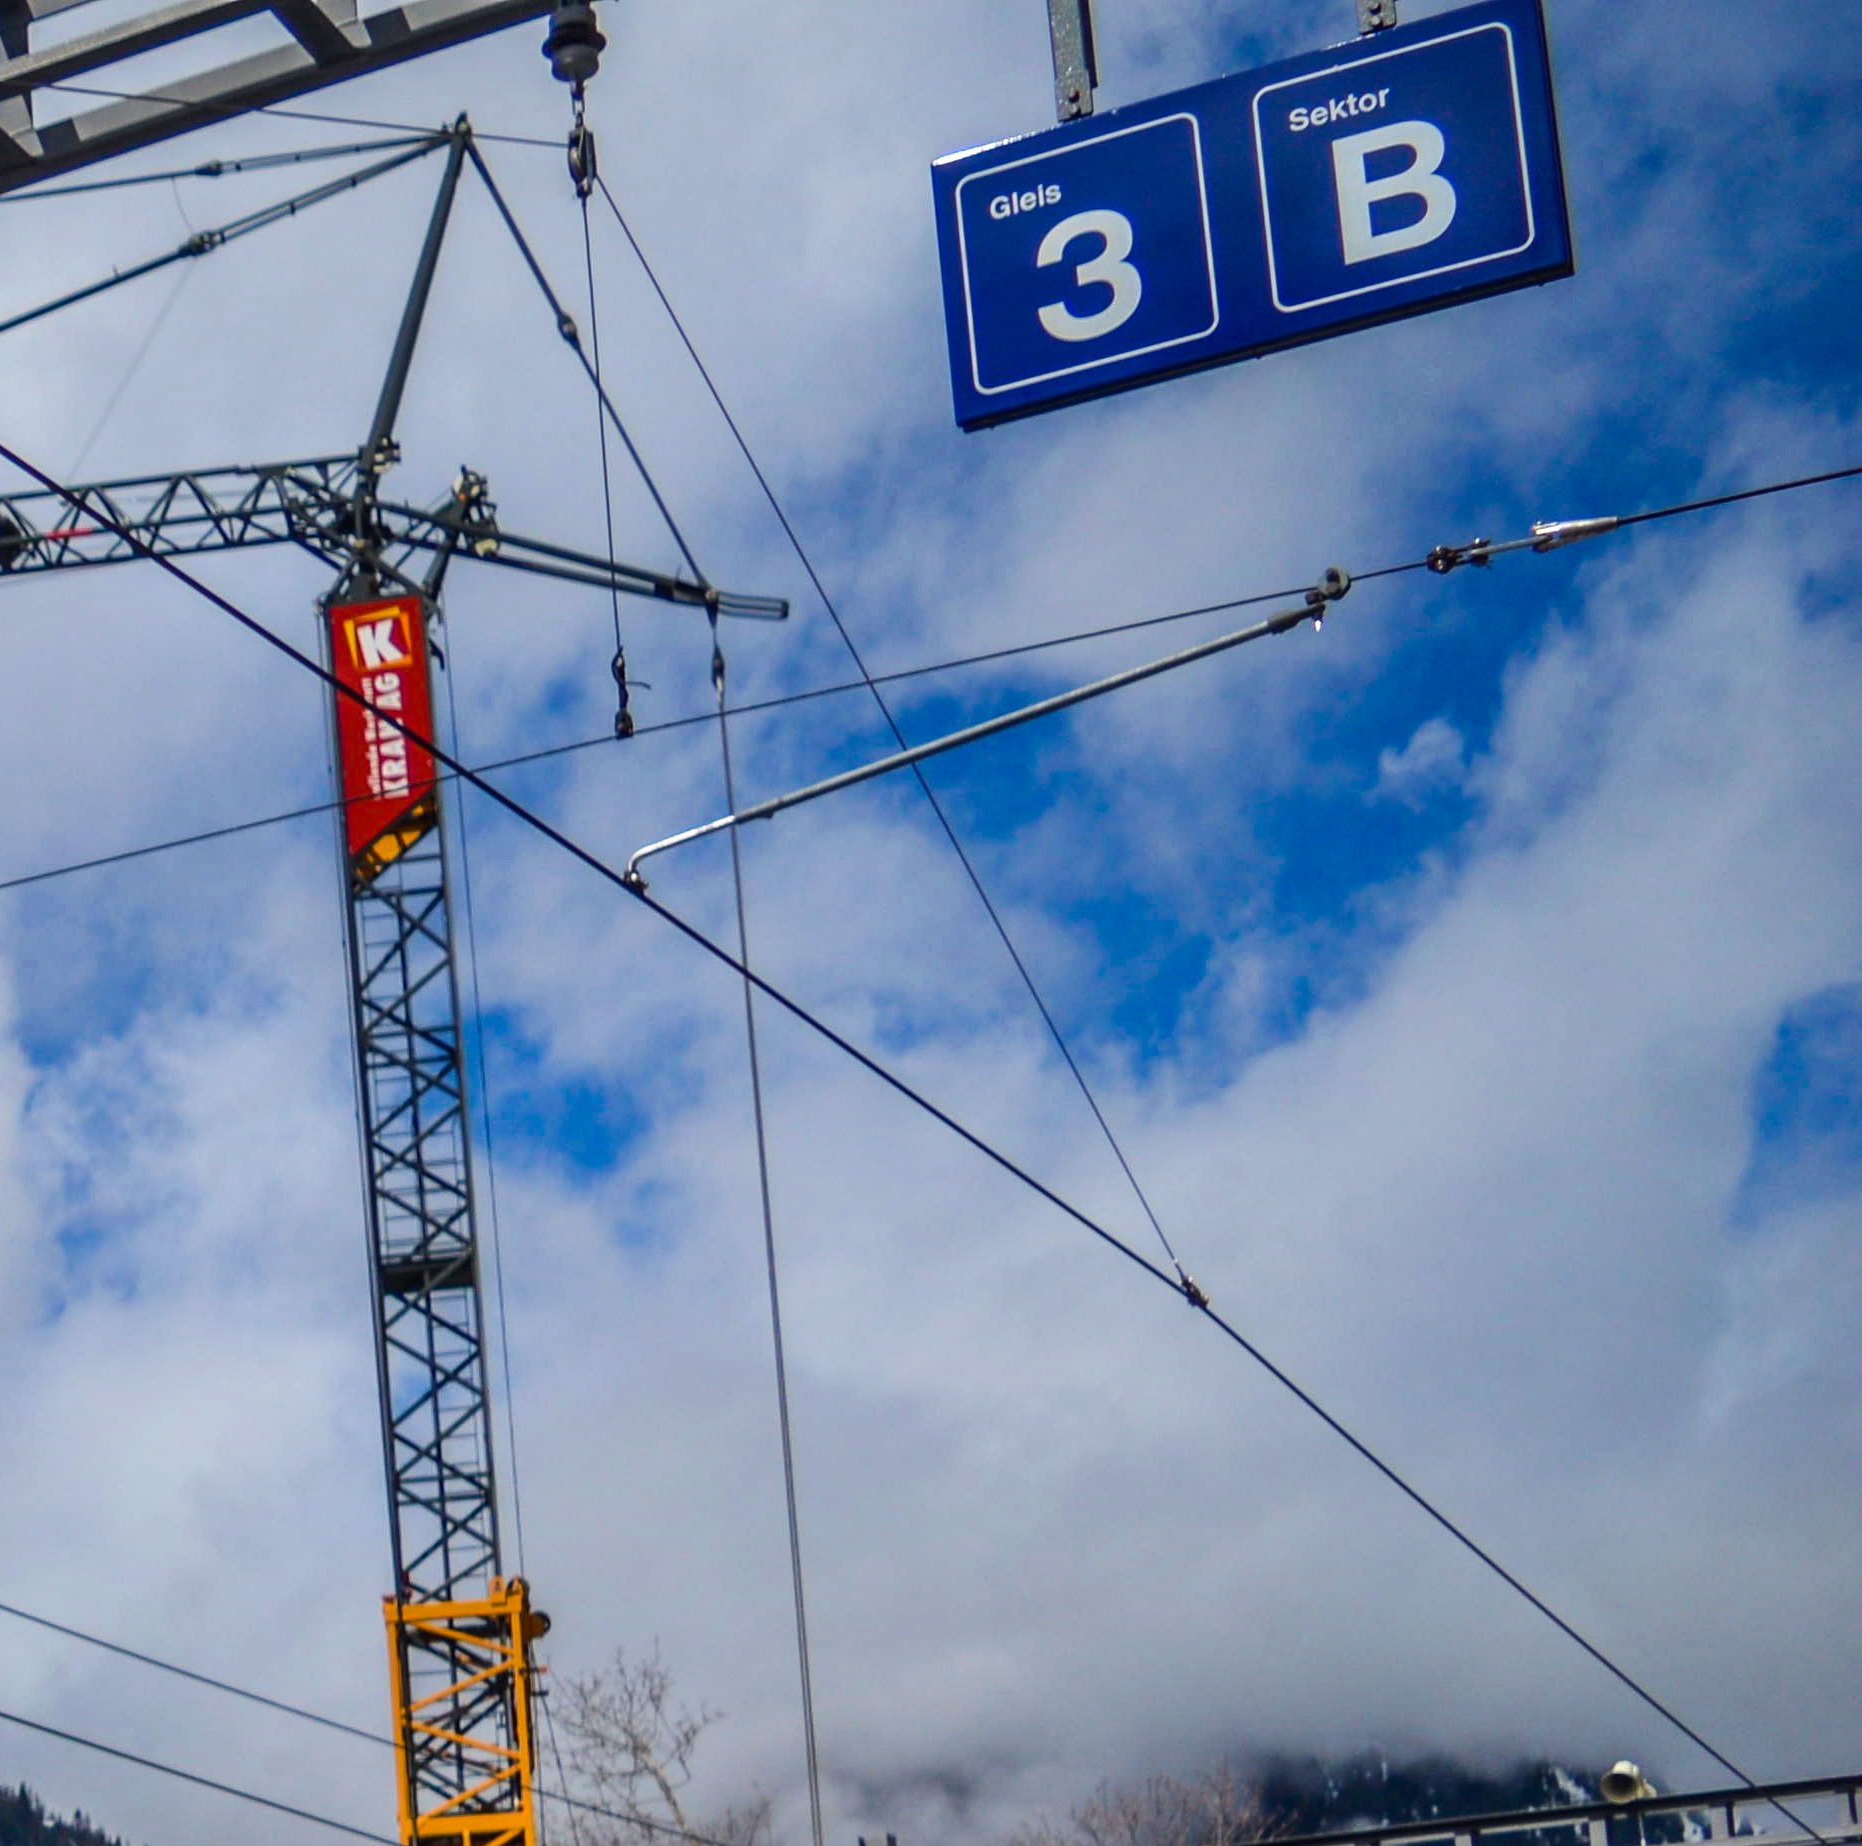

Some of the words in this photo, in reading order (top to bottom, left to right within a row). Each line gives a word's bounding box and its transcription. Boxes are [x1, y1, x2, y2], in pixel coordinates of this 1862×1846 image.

[1288, 84, 1391, 133] Sektor
[989, 181, 1062, 220] Gleis
[1331, 119, 1457, 266] B
[1036, 209, 1142, 343] 3
[357, 618, 407, 670] K
[375, 671, 402, 711] AG
